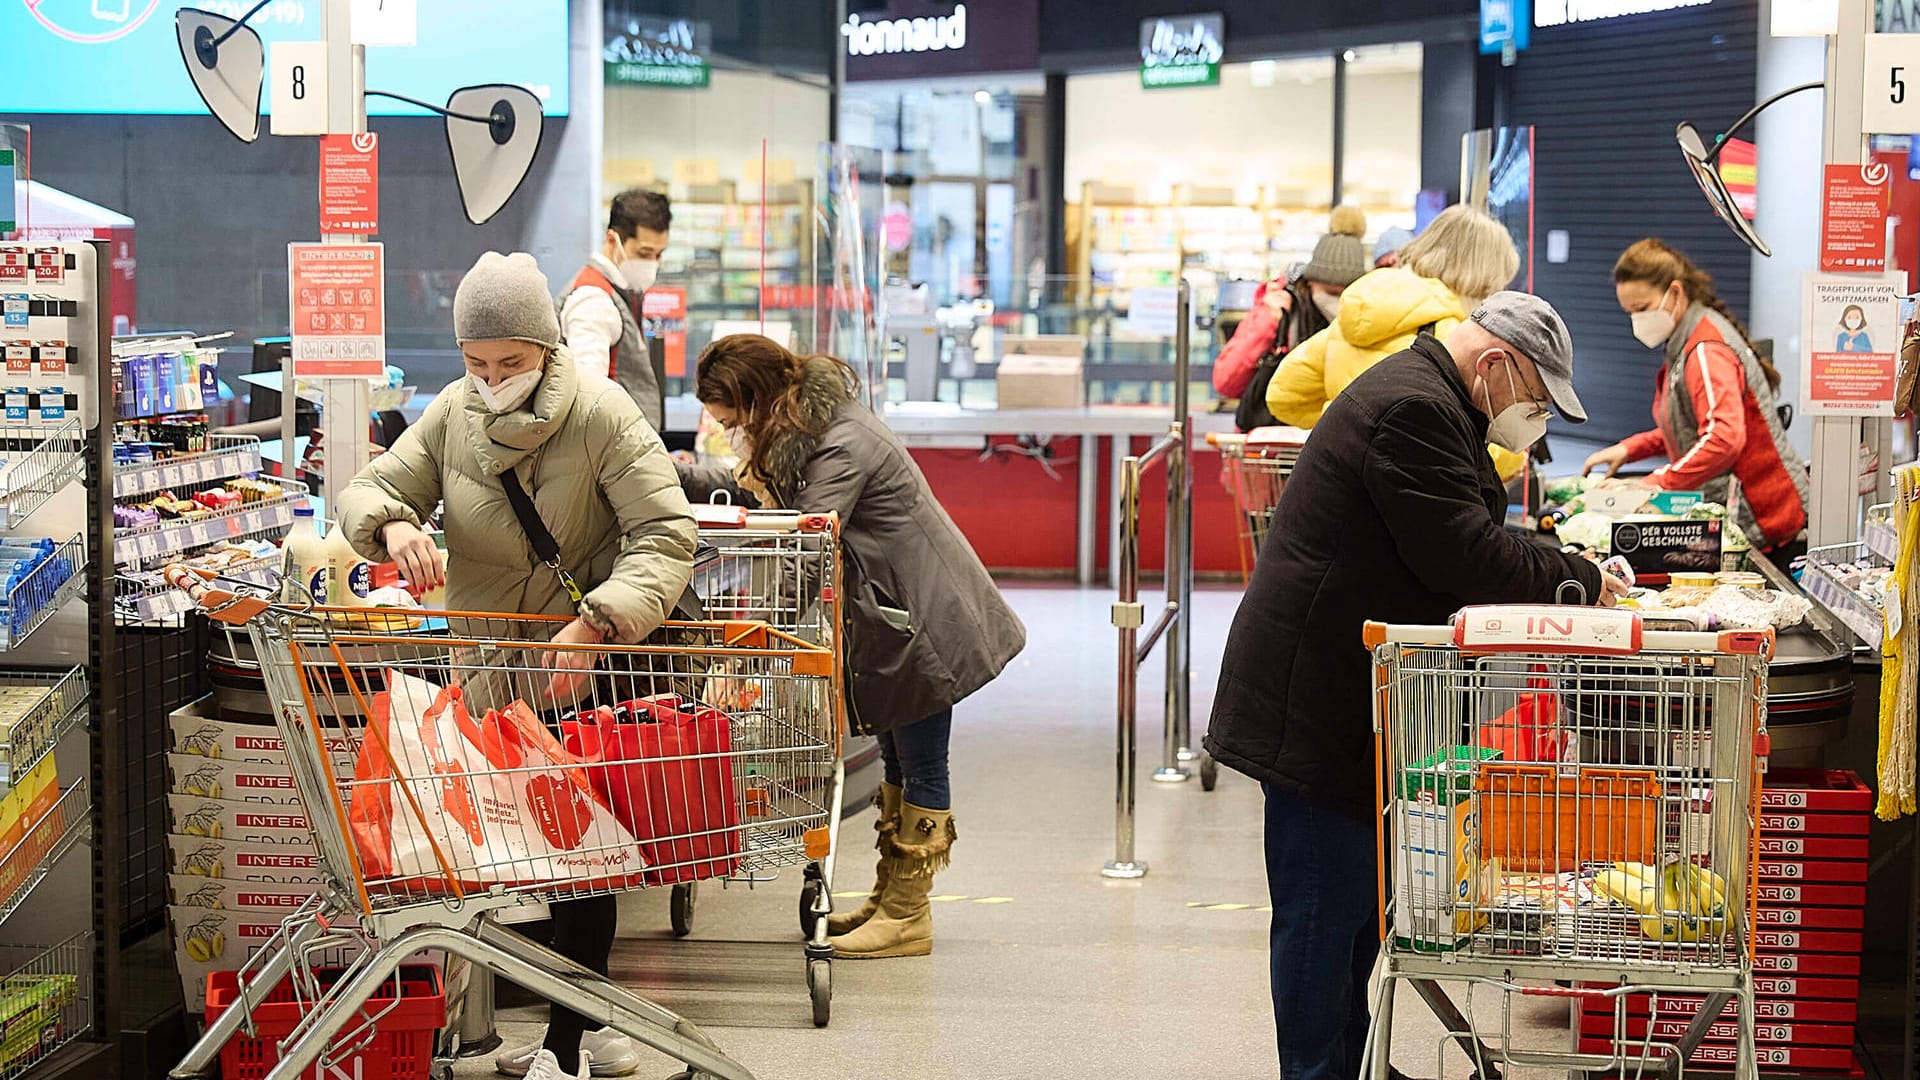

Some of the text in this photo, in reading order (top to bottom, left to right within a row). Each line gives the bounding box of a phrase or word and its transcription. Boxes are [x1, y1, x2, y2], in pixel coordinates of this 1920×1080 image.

[292, 65, 305, 100] 8
[1890, 67, 1905, 104] 5
[1821, 295, 1889, 303] SCHUTZMASKEN
[1663, 525, 1703, 536] VOLLSTE
[1527, 616, 1574, 636] IN
